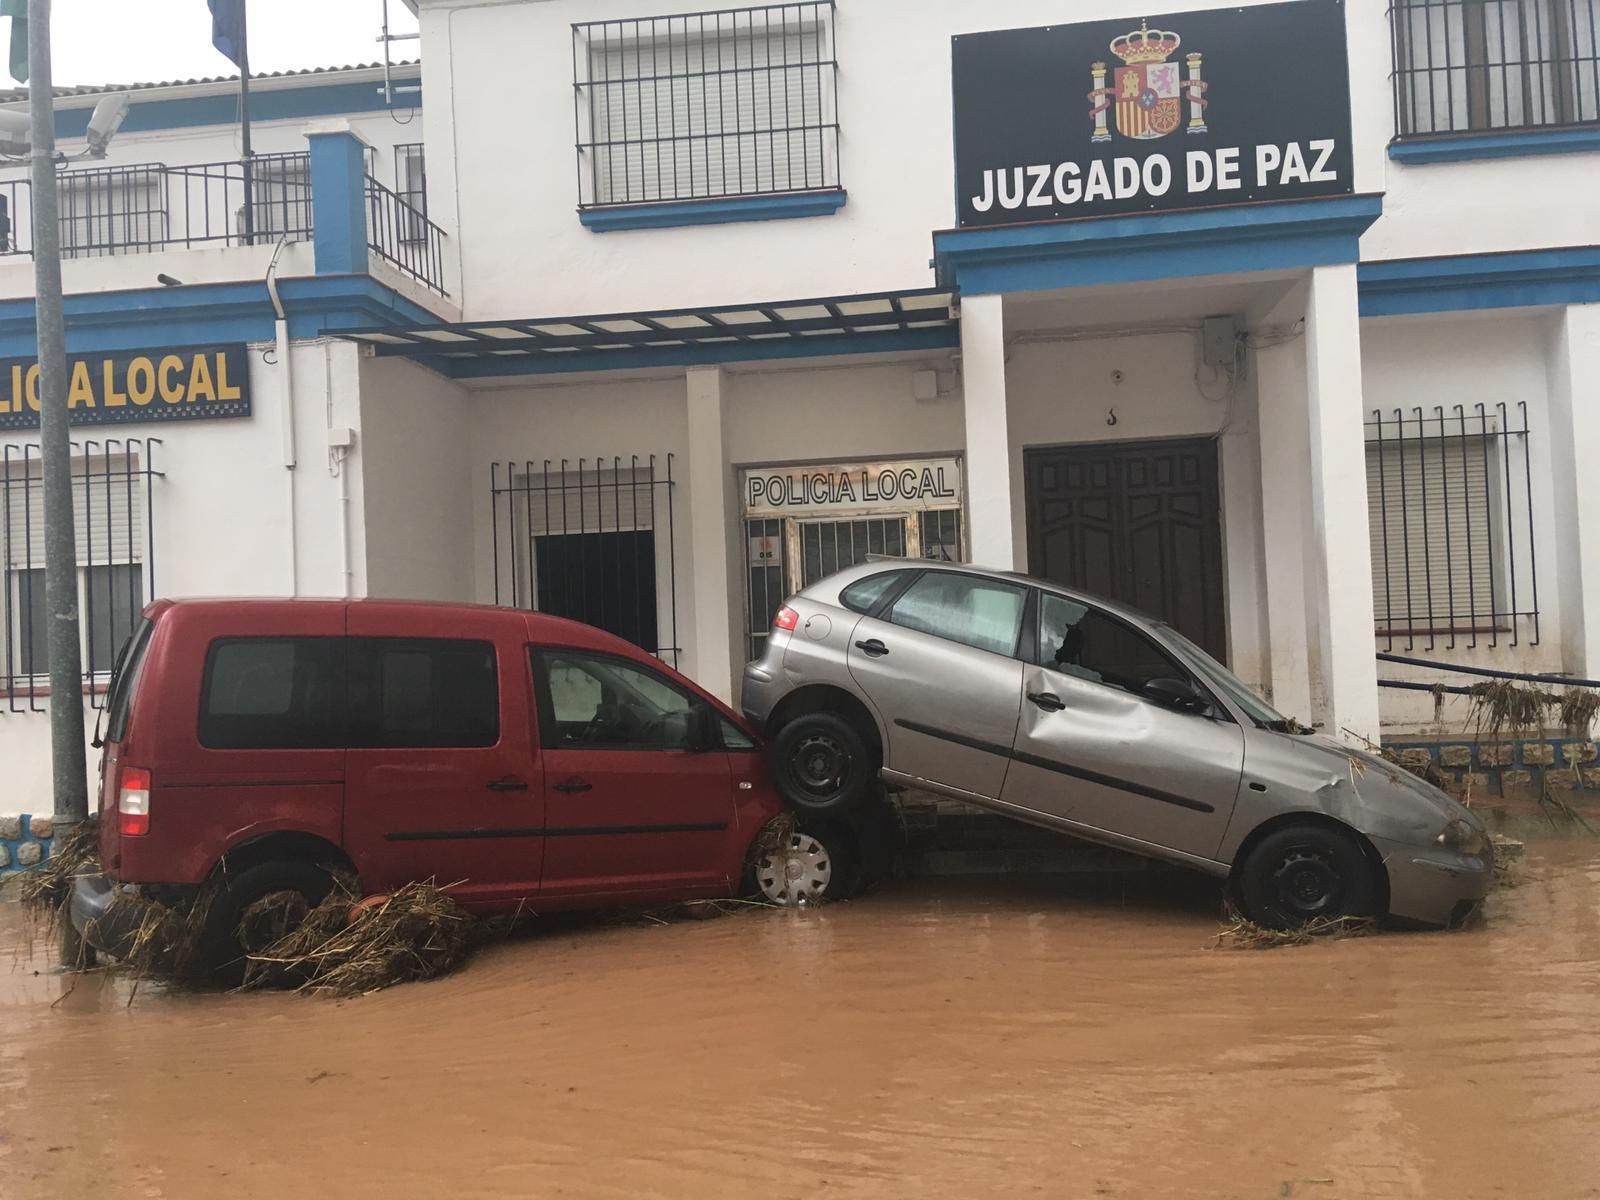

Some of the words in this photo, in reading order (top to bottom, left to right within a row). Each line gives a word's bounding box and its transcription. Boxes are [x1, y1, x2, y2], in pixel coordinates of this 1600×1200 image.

[971, 153, 1172, 212] JUZGADO
[1186, 147, 1241, 193] DE
[1255, 139, 1338, 187] PAZ
[103, 352, 241, 407] LOCAL
[749, 472, 856, 507] POLICIA
[862, 467, 955, 501] LOCAL
